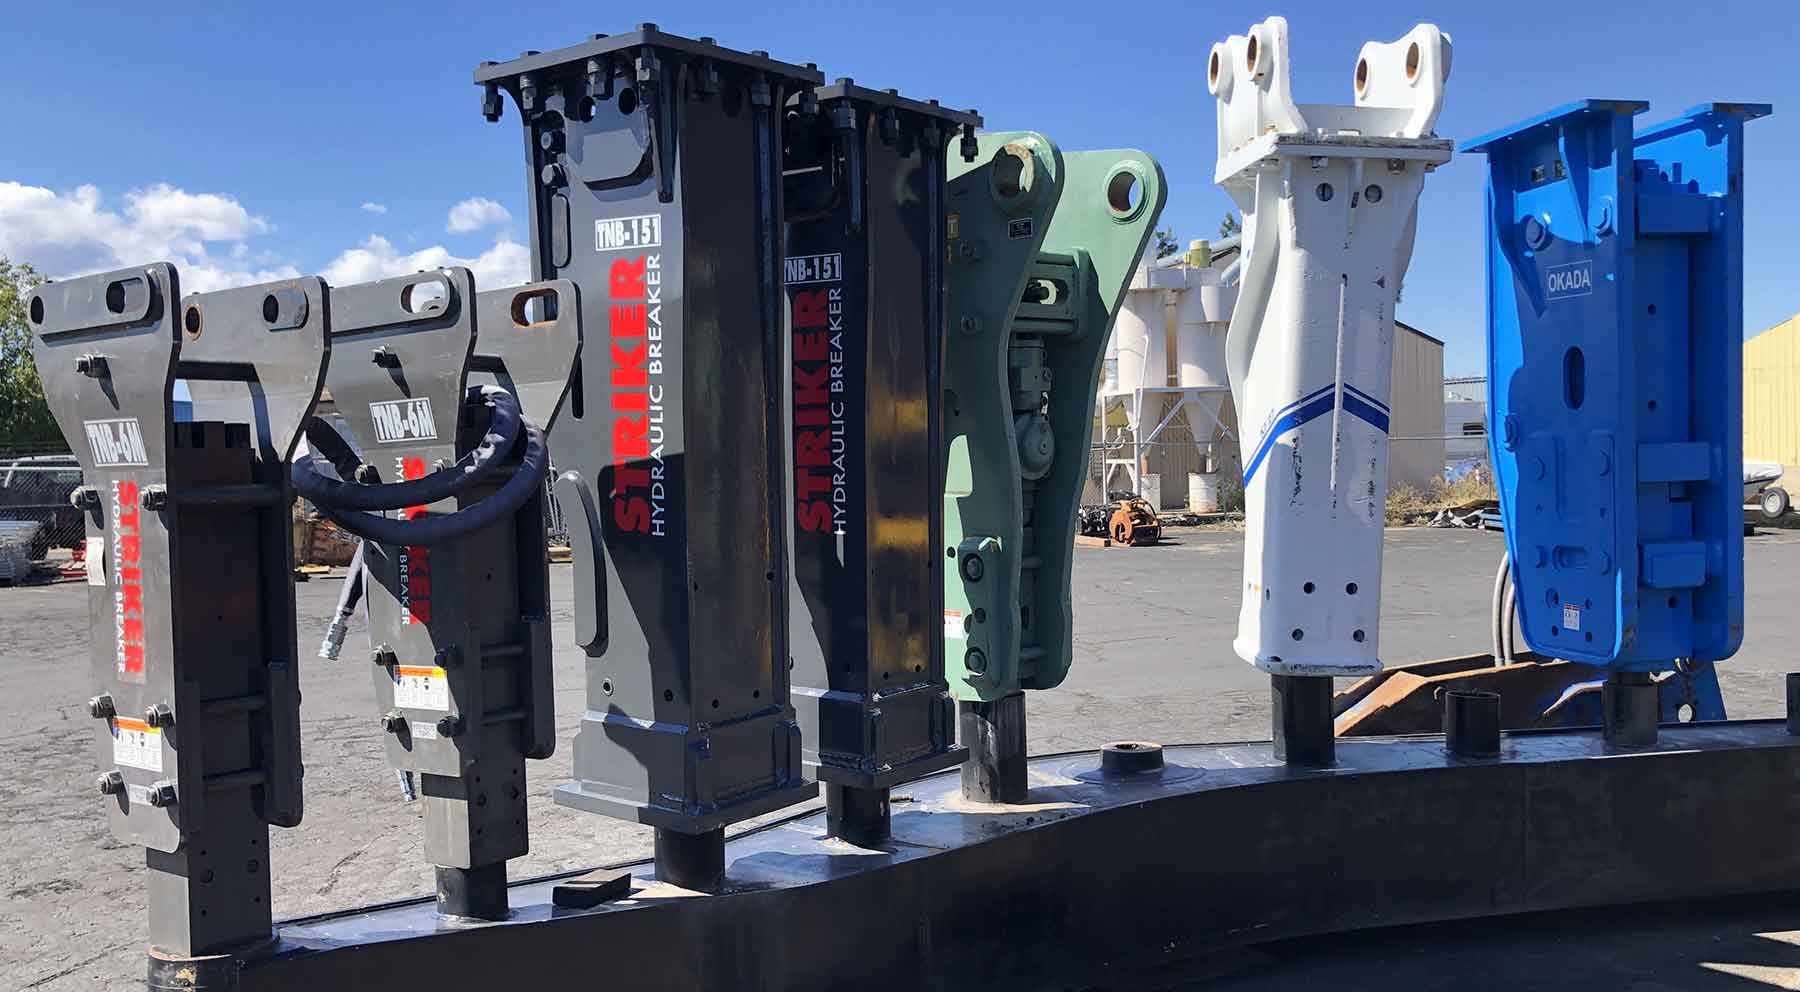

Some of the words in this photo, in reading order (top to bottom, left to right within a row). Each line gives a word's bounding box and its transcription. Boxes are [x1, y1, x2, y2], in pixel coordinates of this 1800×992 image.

[597, 217, 660, 249] TNB-151
[1549, 269, 1590, 292] OKADA
[647, 253, 663, 375] BREAKER
[828, 288, 844, 393] BREAKER
[86, 421, 147, 464] TNB-6M
[372, 400, 437, 440] TNB-6M
[609, 255, 650, 534] STRIKER
[793, 288, 832, 535] STRIKER
[649, 384, 665, 536] HYDRAULIC
[831, 402, 847, 536] HYDRAULIC
[112, 480, 124, 585] HYDRAULIC
[119, 480, 145, 673] STRIKER
[115, 591, 126, 673] BREAKER
[400, 554, 411, 625] BREAKER
